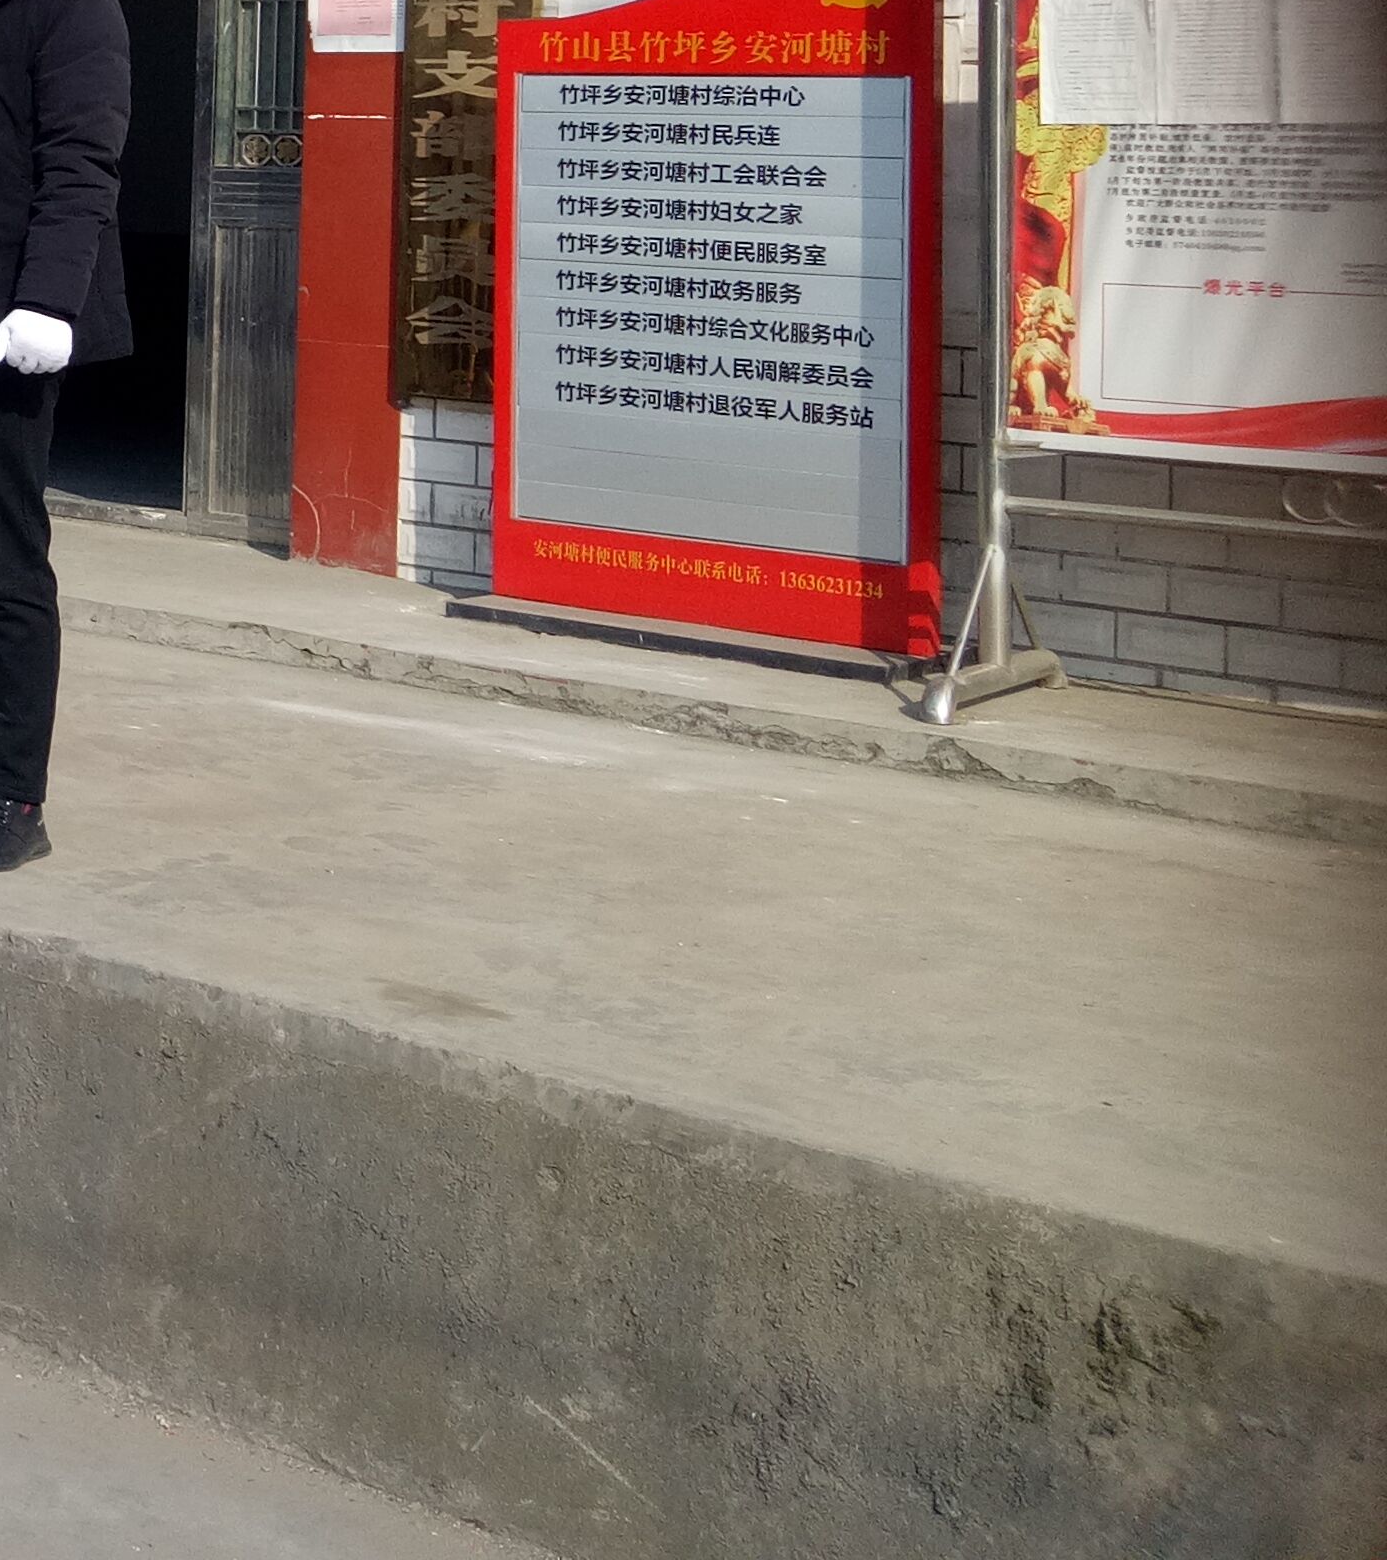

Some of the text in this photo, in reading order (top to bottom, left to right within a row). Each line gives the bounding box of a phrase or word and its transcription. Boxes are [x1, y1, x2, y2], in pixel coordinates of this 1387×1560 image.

[538, 30, 891, 66] 竹山县竹坪乡安河塘村
[559, 83, 806, 108] 竹坪乡安河塘村综治中心
[558, 121, 781, 148] 竹坪乡安河塘村民兵连
[557, 158, 828, 188] 竹坪乡安河塘村工会联合会
[557, 194, 804, 226] 竹坪乡安河塘村妇女之家
[556, 232, 828, 267] 竹坪乡安河塘村便民服务室
[555, 269, 803, 306] 竹坪乡安河塘村政务服务
[555, 306, 876, 349] 竹坪乡安河塘村综合文化服务中心
[555, 344, 875, 389] 竹坪乡安河塘村人民调解委员会
[555, 381, 874, 430] 竹坪乡安河塘村退役军人服务站
